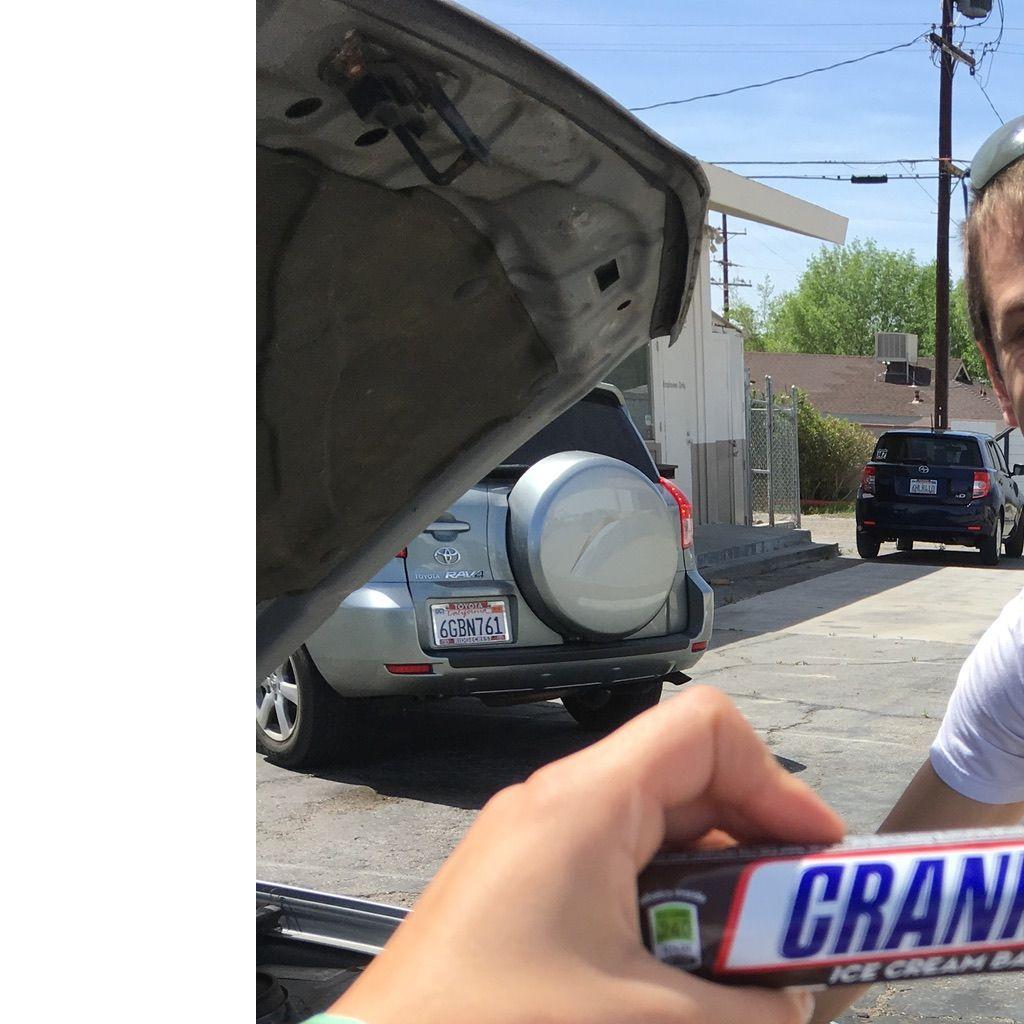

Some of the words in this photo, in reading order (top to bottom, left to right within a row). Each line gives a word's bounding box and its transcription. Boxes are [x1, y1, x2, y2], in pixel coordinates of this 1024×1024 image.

[445, 570, 484, 579] RAV4
[454, 601, 484, 610] TOYOTA
[439, 616, 503, 638] 6GBN761
[829, 963, 882, 985] ICE
[883, 953, 988, 980] CREAM
